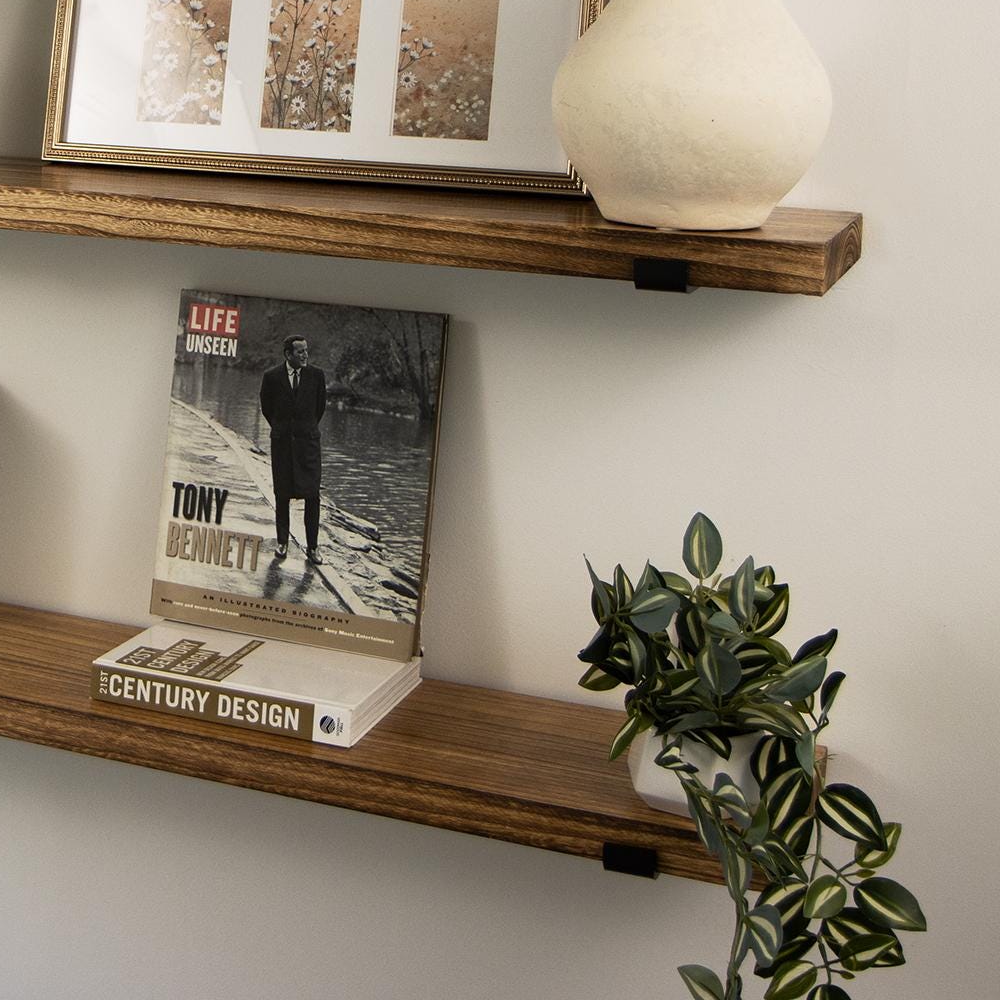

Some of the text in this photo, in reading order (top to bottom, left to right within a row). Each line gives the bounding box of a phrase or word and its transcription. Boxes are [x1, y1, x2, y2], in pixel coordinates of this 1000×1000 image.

[190, 305, 238, 334] LIFE
[185, 333, 238, 358] UNSEEN
[172, 481, 229, 525] TONY
[166, 520, 264, 572] BENNETT
[219, 597, 287, 614] ILLUSTRATED
[292, 609, 350, 625] BIOGRAPHY
[324, 627, 338, 635] Sony
[338, 629, 355, 638] Music
[355, 632, 395, 645] Entertainment
[123, 647, 158, 665] 21ST
[147, 640, 200, 669] CENTURY
[169, 651, 217, 673] DESIGN
[99, 670, 109, 695] 21ST
[108, 673, 300, 731] CENTURY DESIGN
